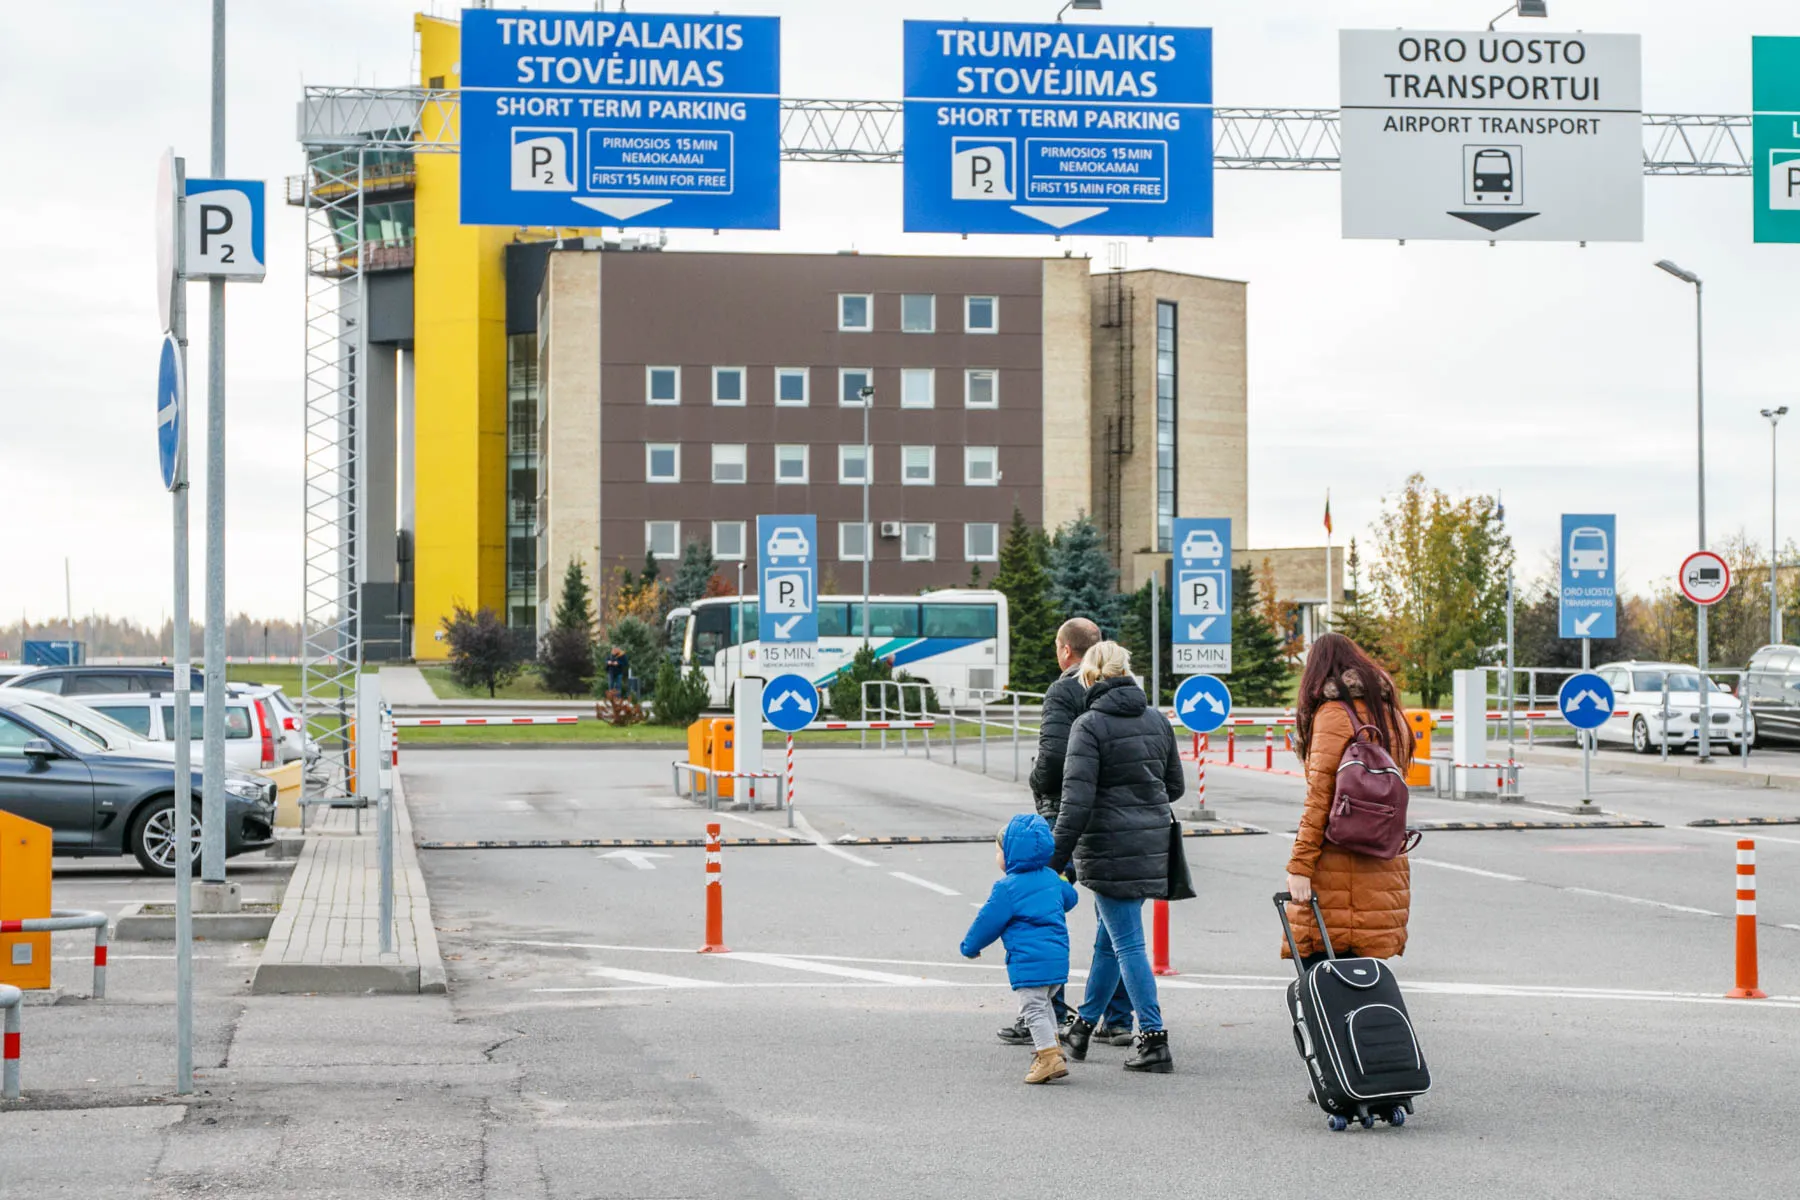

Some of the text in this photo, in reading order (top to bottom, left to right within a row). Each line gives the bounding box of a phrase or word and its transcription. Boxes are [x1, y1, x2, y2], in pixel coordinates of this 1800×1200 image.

[497, 18, 743, 50] TRUMPALAIKIS
[937, 30, 1176, 61] TRUMPALAIKIS
[1399, 37, 1585, 64] ORO UOSTO
[517, 52, 724, 87] STOVĖJIMAS
[957, 63, 1158, 97] STOVĖJIMAS
[1384, 74, 1599, 101] TRANSPORTUI
[497, 97, 746, 120] SHORT TERM PARKING
[937, 107, 1180, 130] SHORT TERM PARKING
[1384, 116, 1600, 135] AIRPORT TRANSPORT
[603, 137, 718, 151] PIRMOSIOS 15 MIN
[1041, 147, 1153, 160] PIRMOSIOS 15 MIN
[622, 152, 704, 164] NEMOKAMAI
[1059, 162, 1139, 174] NEMOKAMAI
[592, 173, 726, 187] FIRST 15 MIN FOR FREE
[1031, 182, 1161, 196] FIRST 15 MIN FOR FREE
[763, 648, 779, 660] 15
[784, 648, 815, 660] MIN.
[1177, 649, 1193, 661] 15
